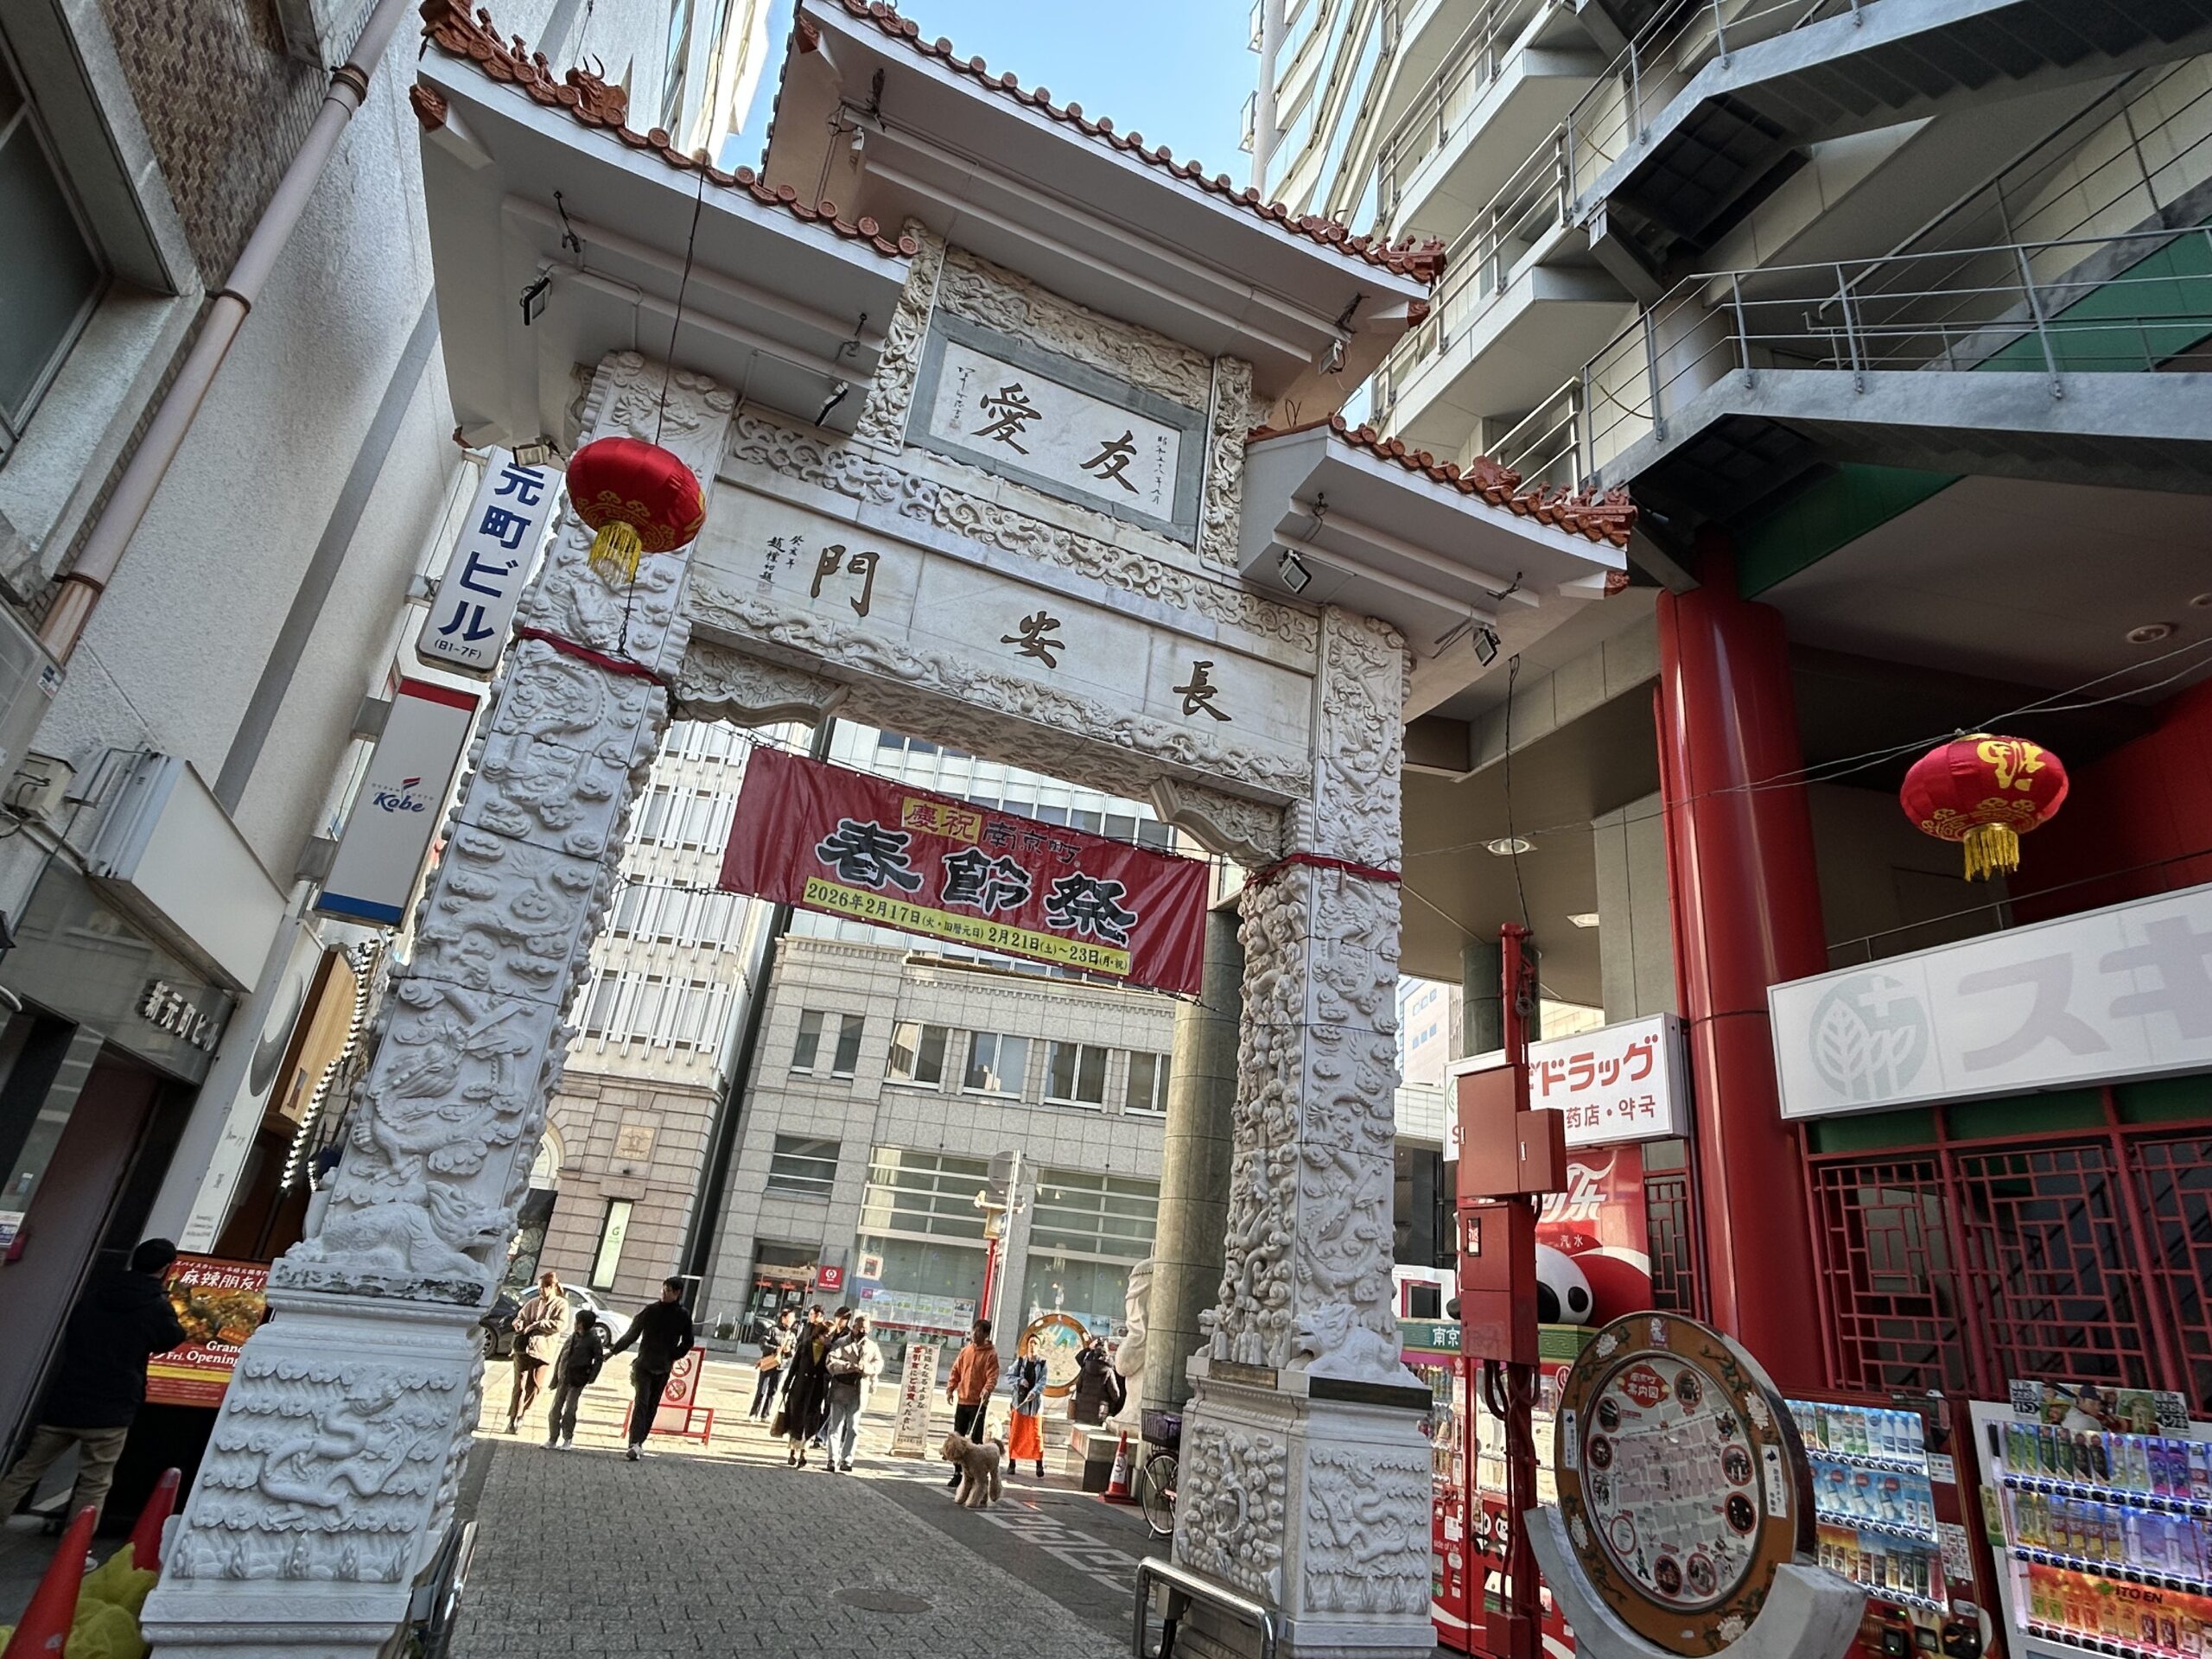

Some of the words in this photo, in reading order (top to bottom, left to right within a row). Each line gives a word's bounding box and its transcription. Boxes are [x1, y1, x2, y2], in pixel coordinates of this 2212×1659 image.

[439, 461, 545, 642] 元町ビル
[434, 639, 482, 659] (B1-7F)
[372, 791, 425, 812] Kobe
[904, 803, 976, 842] 慶祝
[982, 821, 1081, 863] 南京町
[1560, 1235, 1584, 1248] 汽水
[181, 1268, 264, 1293] 麻辣朋友!
[1432, 1325, 1460, 1347] 南京
[2116, 1585, 2141, 1599] ITO
[2144, 1592, 2163, 1605] EN
